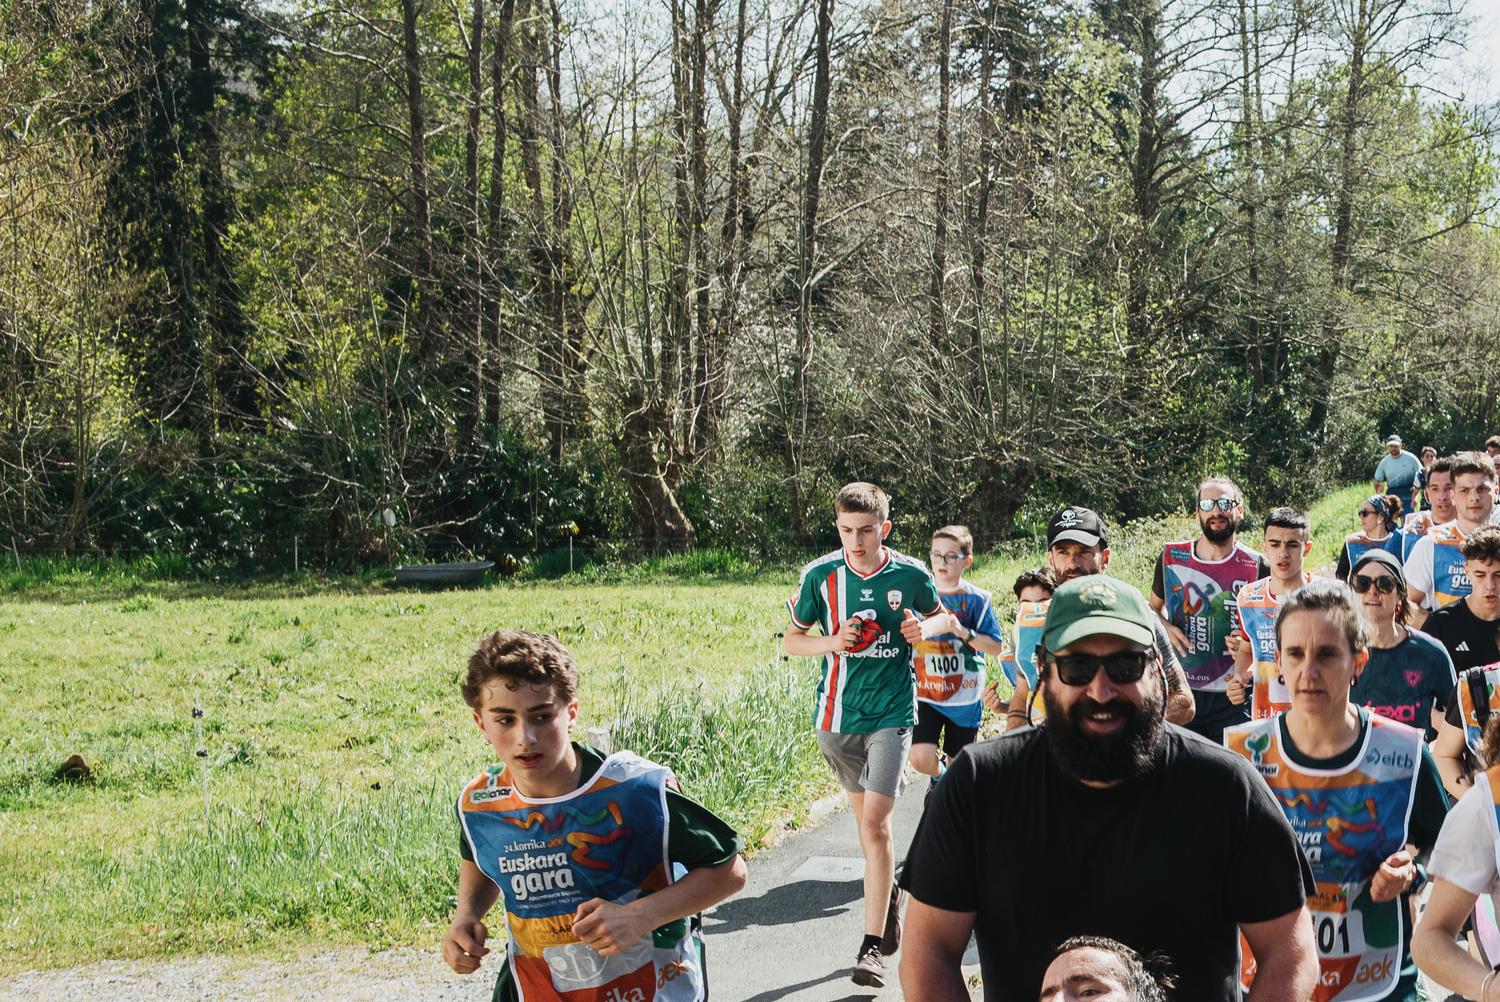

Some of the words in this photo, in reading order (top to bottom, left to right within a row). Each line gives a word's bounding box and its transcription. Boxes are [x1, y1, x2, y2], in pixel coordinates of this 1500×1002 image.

[1448, 565, 1466, 575] Eus
[1197, 616, 1211, 652] gara
[930, 654, 959, 674] 1400
[1257, 706, 1283, 719] 24.ko
[1382, 751, 1414, 769] eitb
[504, 839, 546, 853] 24.korrika
[1297, 830, 1322, 846] ara
[498, 853, 568, 874] Euskara
[511, 868, 575, 901] gara
[1312, 915, 1350, 955] 01
[657, 953, 690, 990] aek
[1355, 953, 1394, 983] aek
